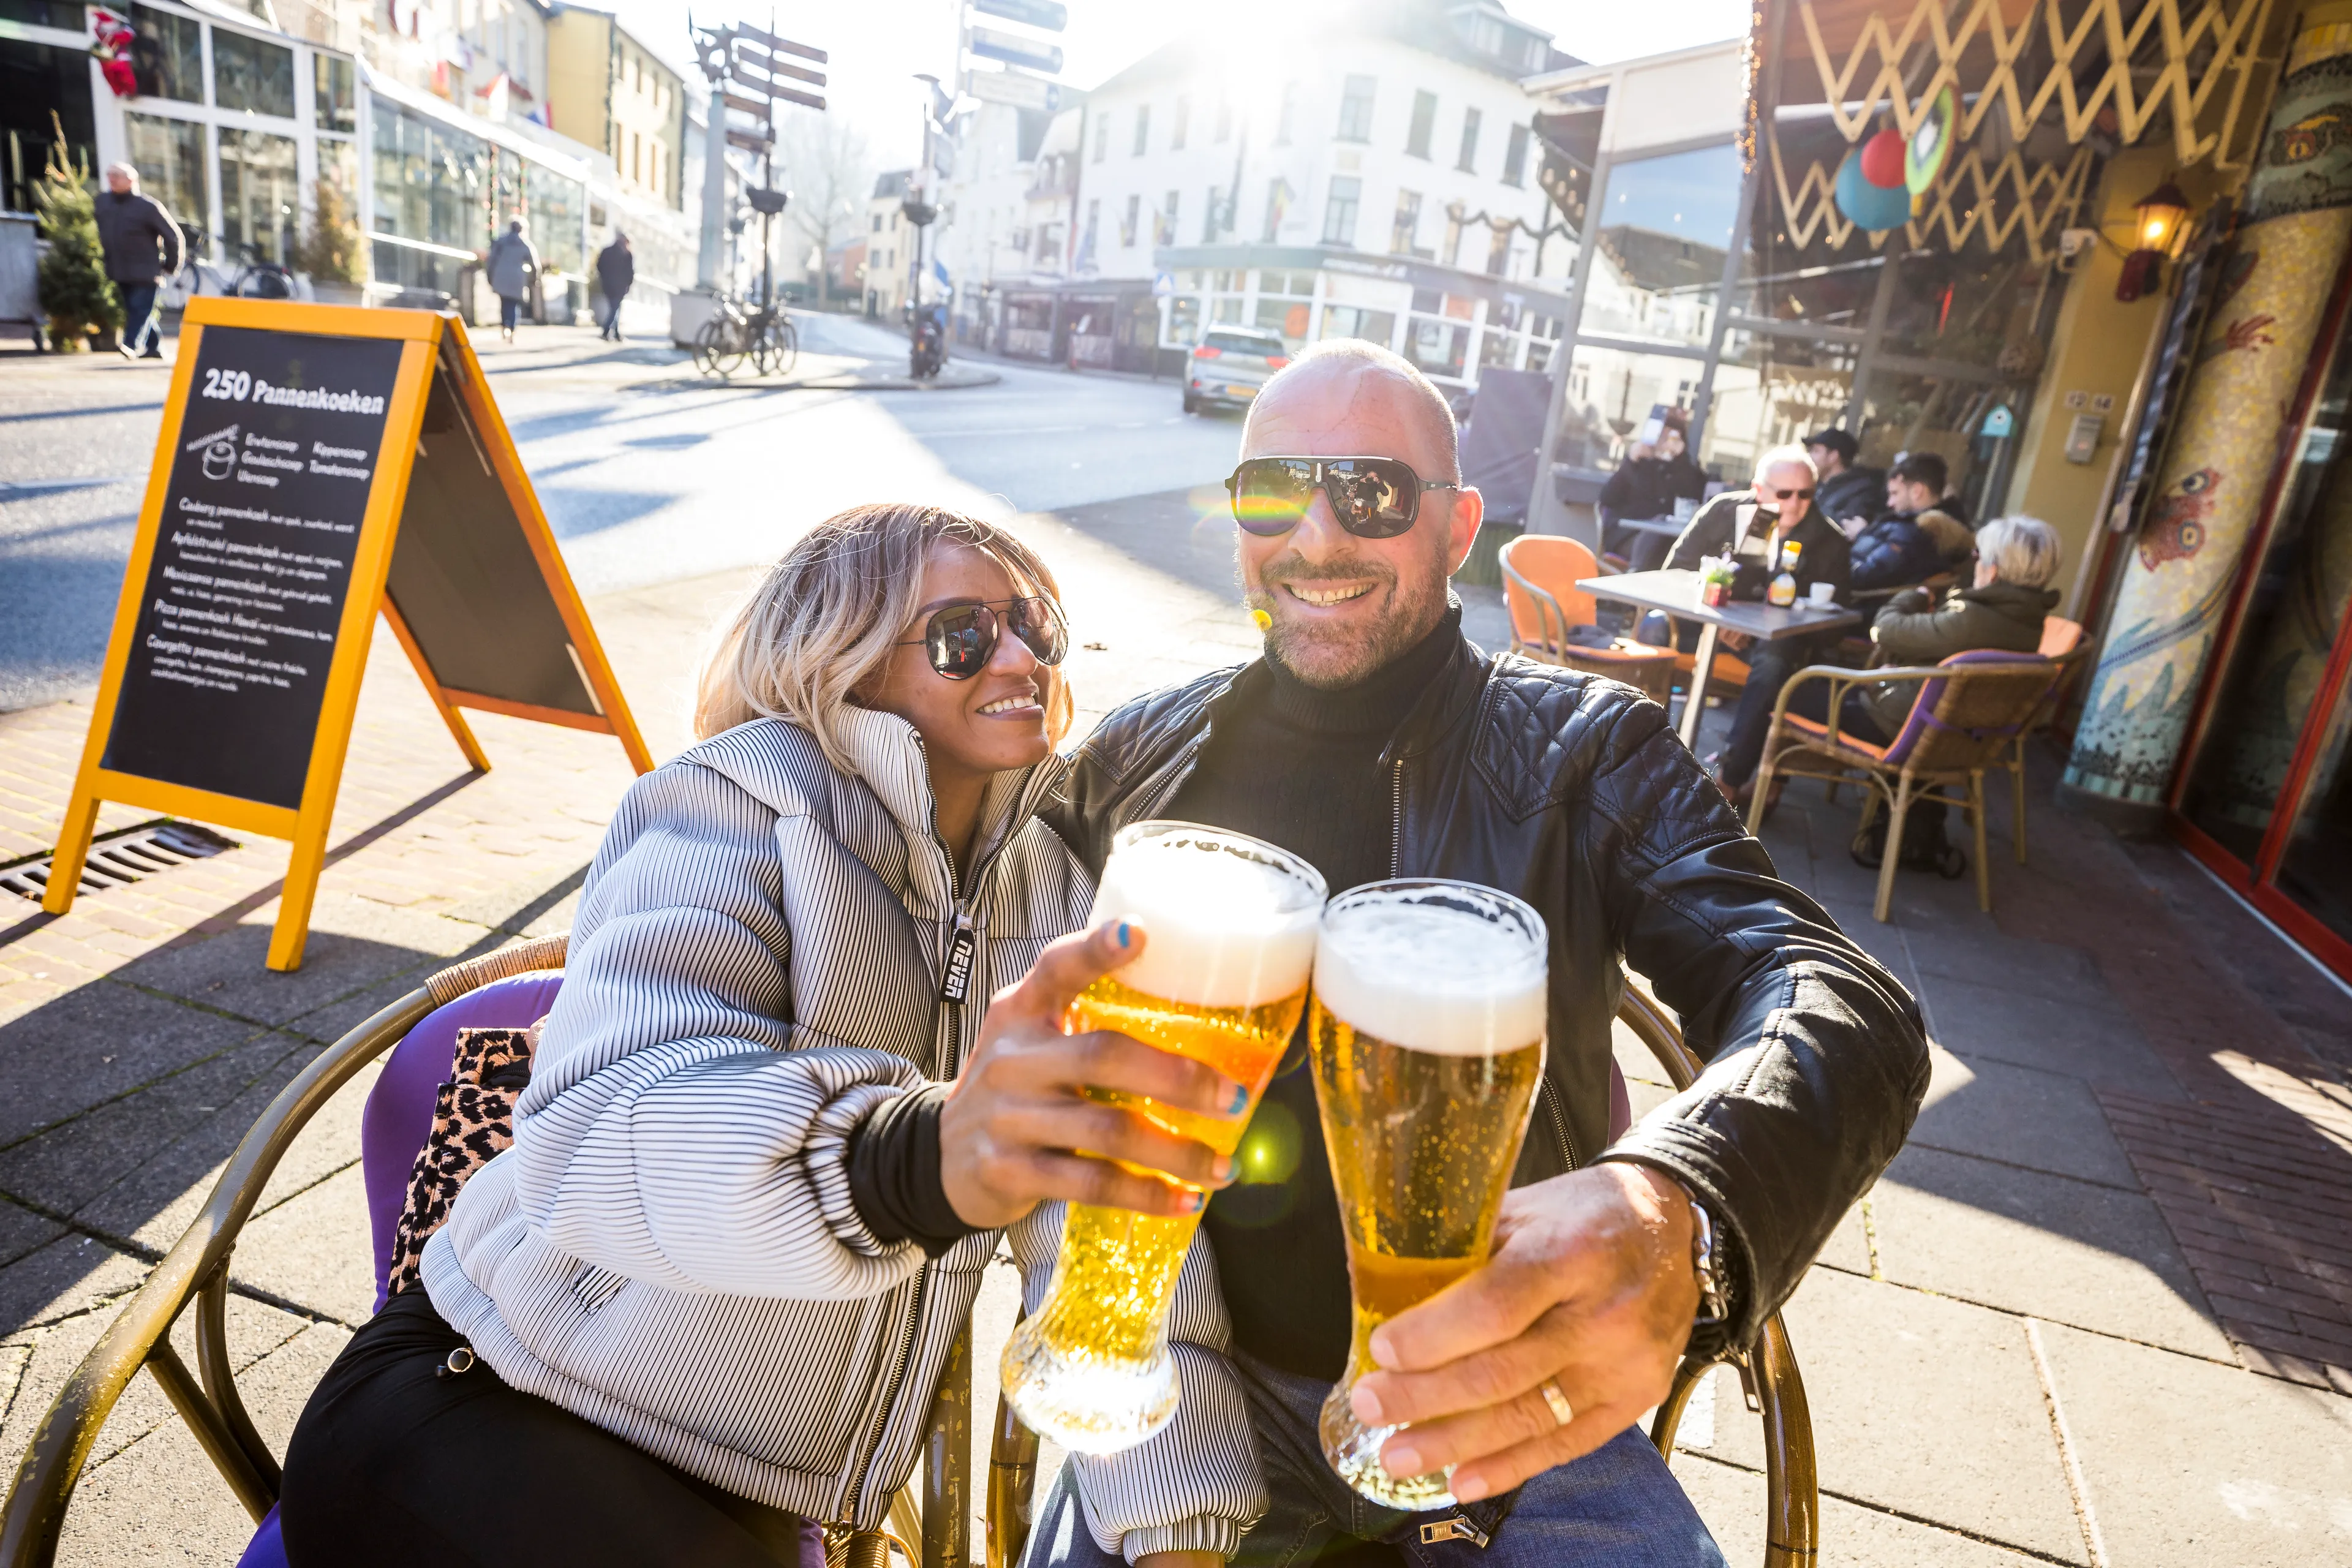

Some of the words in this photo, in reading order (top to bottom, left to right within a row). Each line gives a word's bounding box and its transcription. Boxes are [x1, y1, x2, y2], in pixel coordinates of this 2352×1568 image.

[203, 368, 251, 401] 250
[252, 380, 384, 414] Pannenkoeken
[246, 432, 299, 454] Erwtensoep
[313, 441, 368, 462] Kippensoep
[241, 450, 304, 473] Goulaschsoep
[310, 459, 370, 481] Tomatensoep
[237, 469, 279, 488] Uiensoep
[216, 506, 269, 522] pannenkoek
[226, 538, 279, 558] pannenkoek
[163, 565, 214, 586] Mexicaanse
[214, 578, 266, 594] pannenkoek
[154, 598, 179, 615] Pizza
[178, 606, 232, 624] pannenkoek
[147, 633, 193, 654] Courgette
[192, 647, 246, 664] pannenkoek
[945, 940, 972, 998] NEVER
